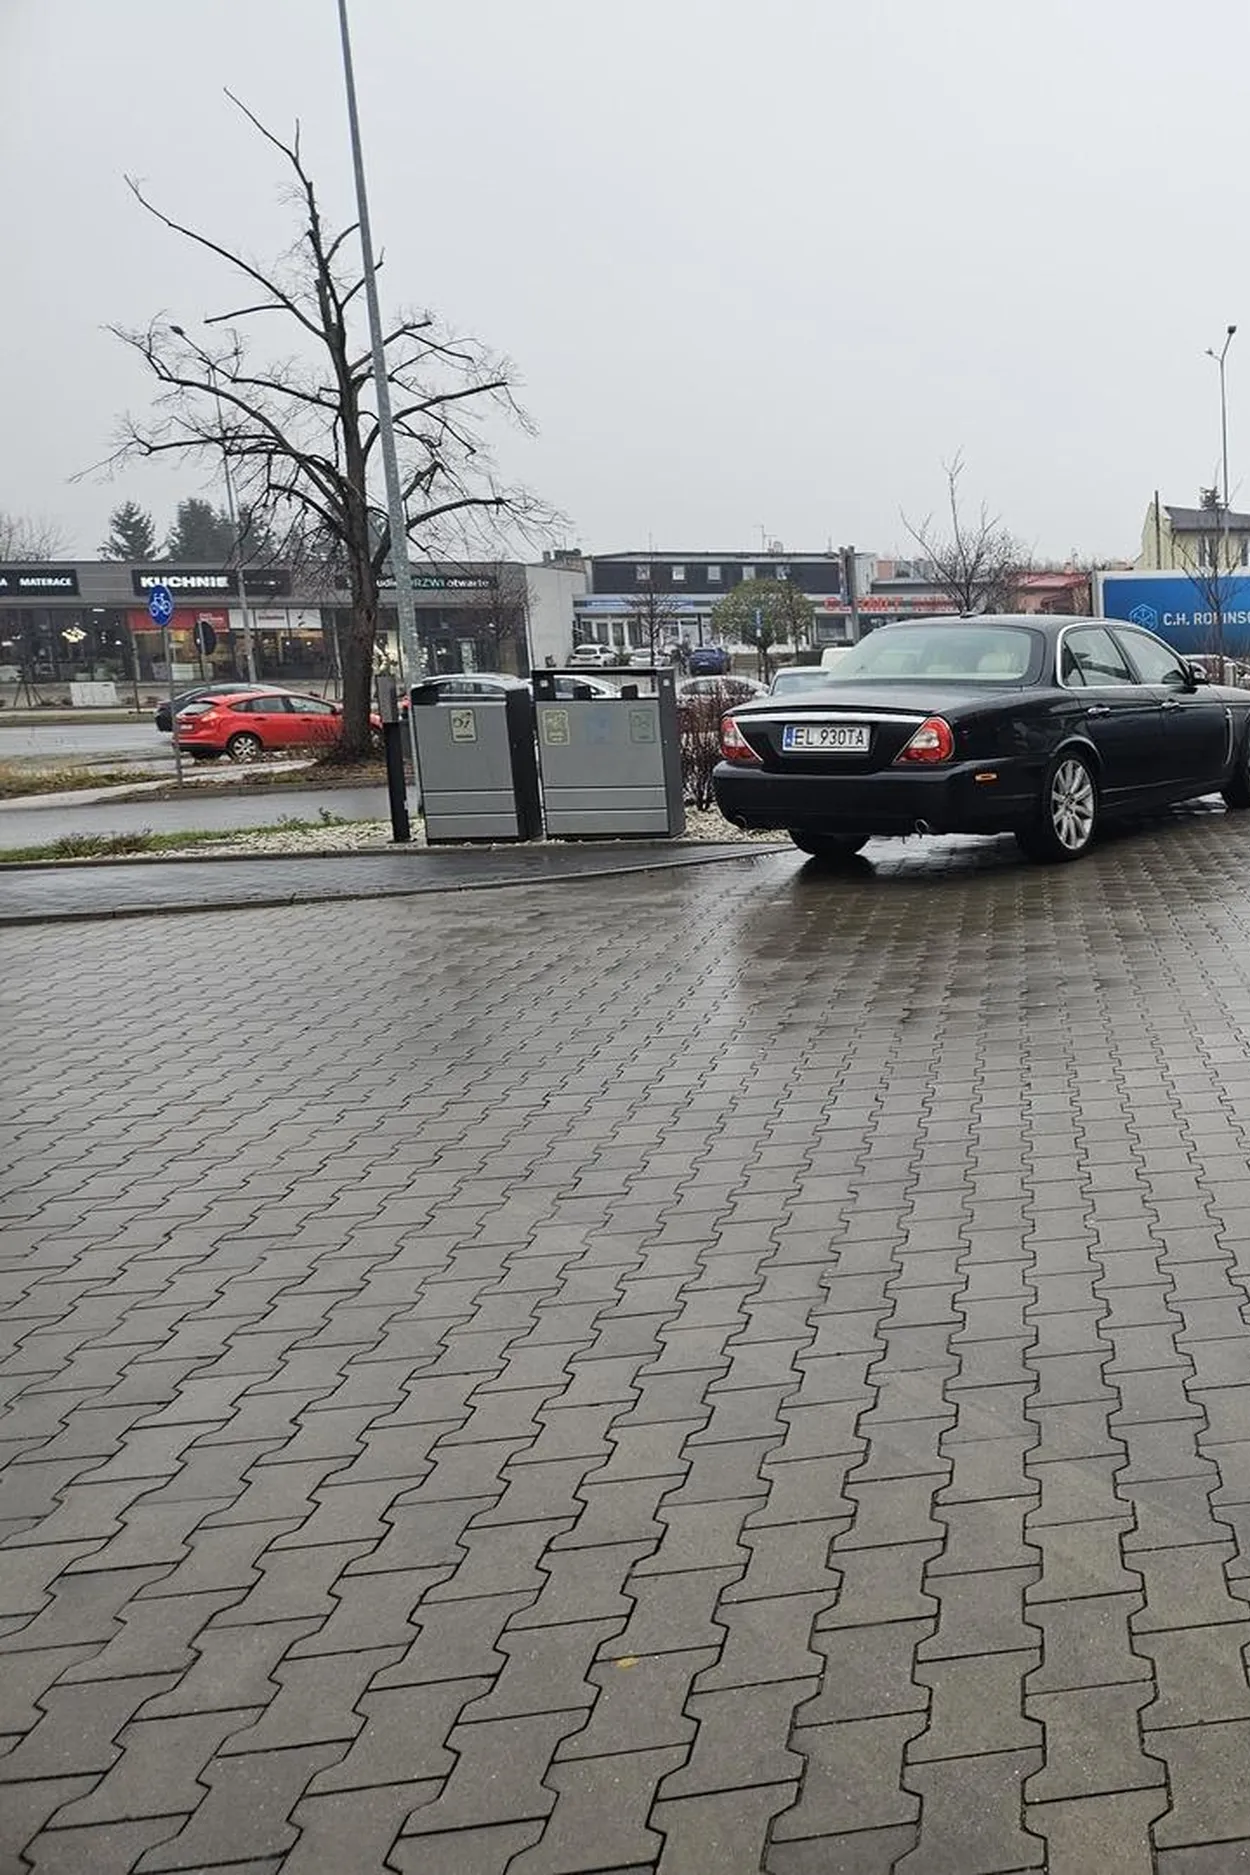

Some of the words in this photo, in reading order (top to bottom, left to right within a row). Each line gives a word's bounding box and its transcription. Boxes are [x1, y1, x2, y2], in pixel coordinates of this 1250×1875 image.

[19, 577, 73, 587] MATERACE
[140, 576, 230, 588] KUCHNIE
[1163, 611, 1190, 626] C.H.
[795, 728, 813, 746] EL
[820, 728, 864, 746] 930TA
